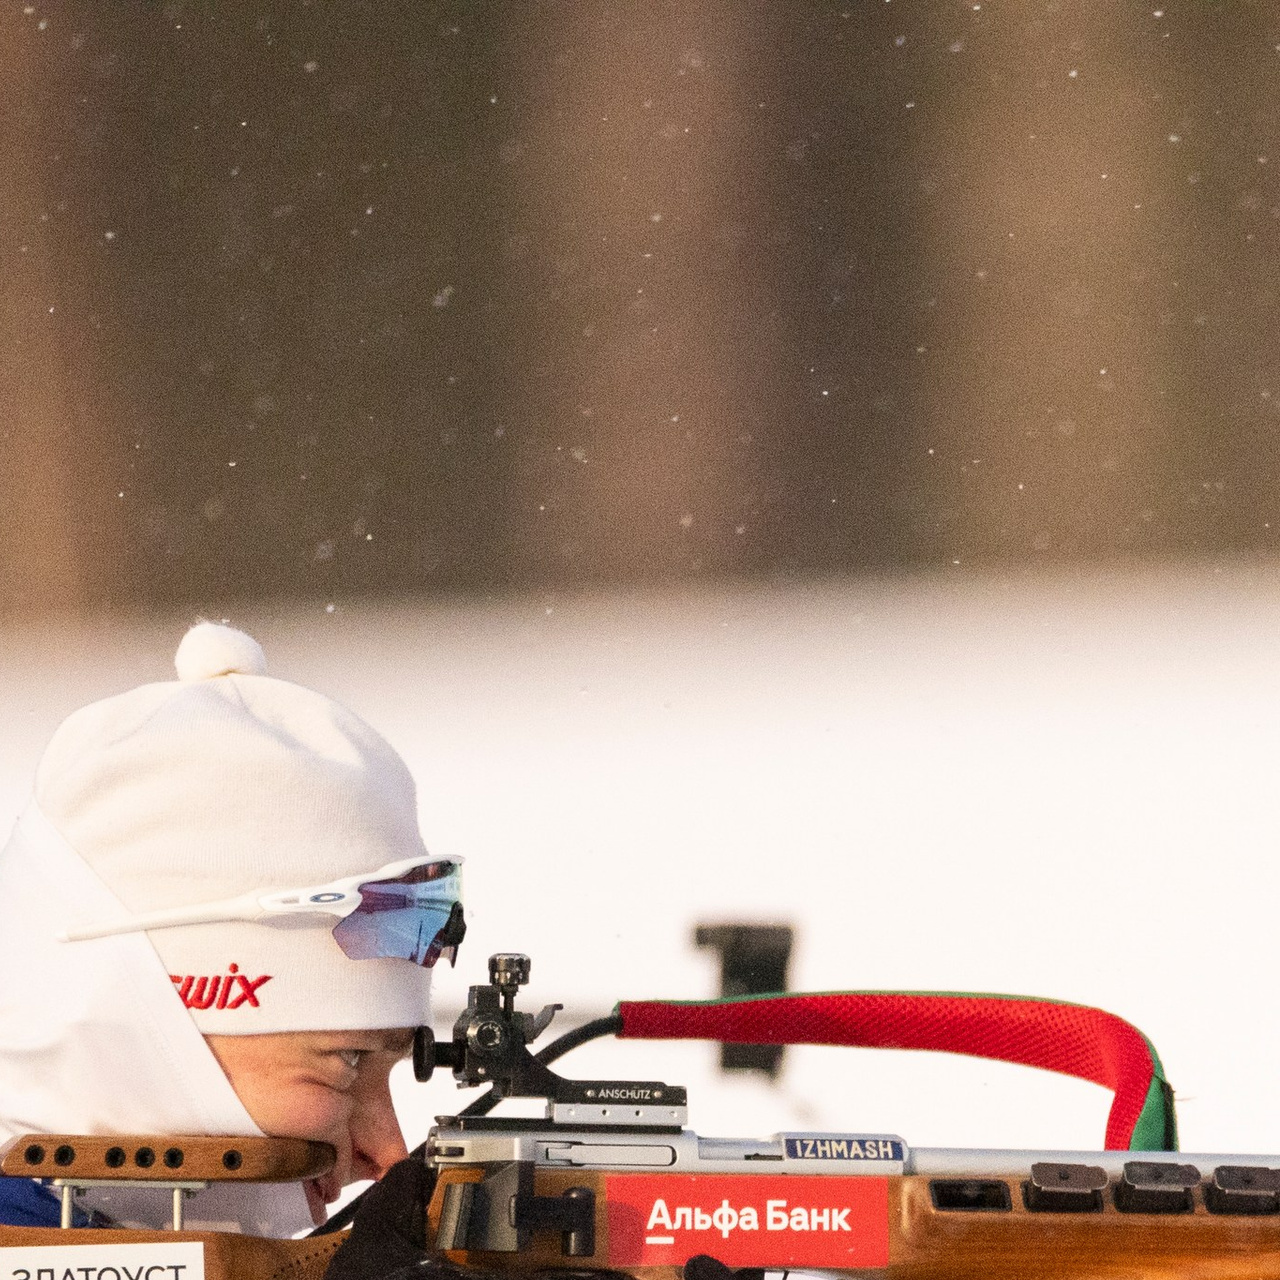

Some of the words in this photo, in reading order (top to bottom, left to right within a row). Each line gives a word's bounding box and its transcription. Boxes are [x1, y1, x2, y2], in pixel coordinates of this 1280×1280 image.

[169, 962, 274, 1010] wix
[795, 1140, 893, 1159] IZHMASH
[646, 1198, 759, 1239] Альфа
[766, 1199, 852, 1232] Банк
